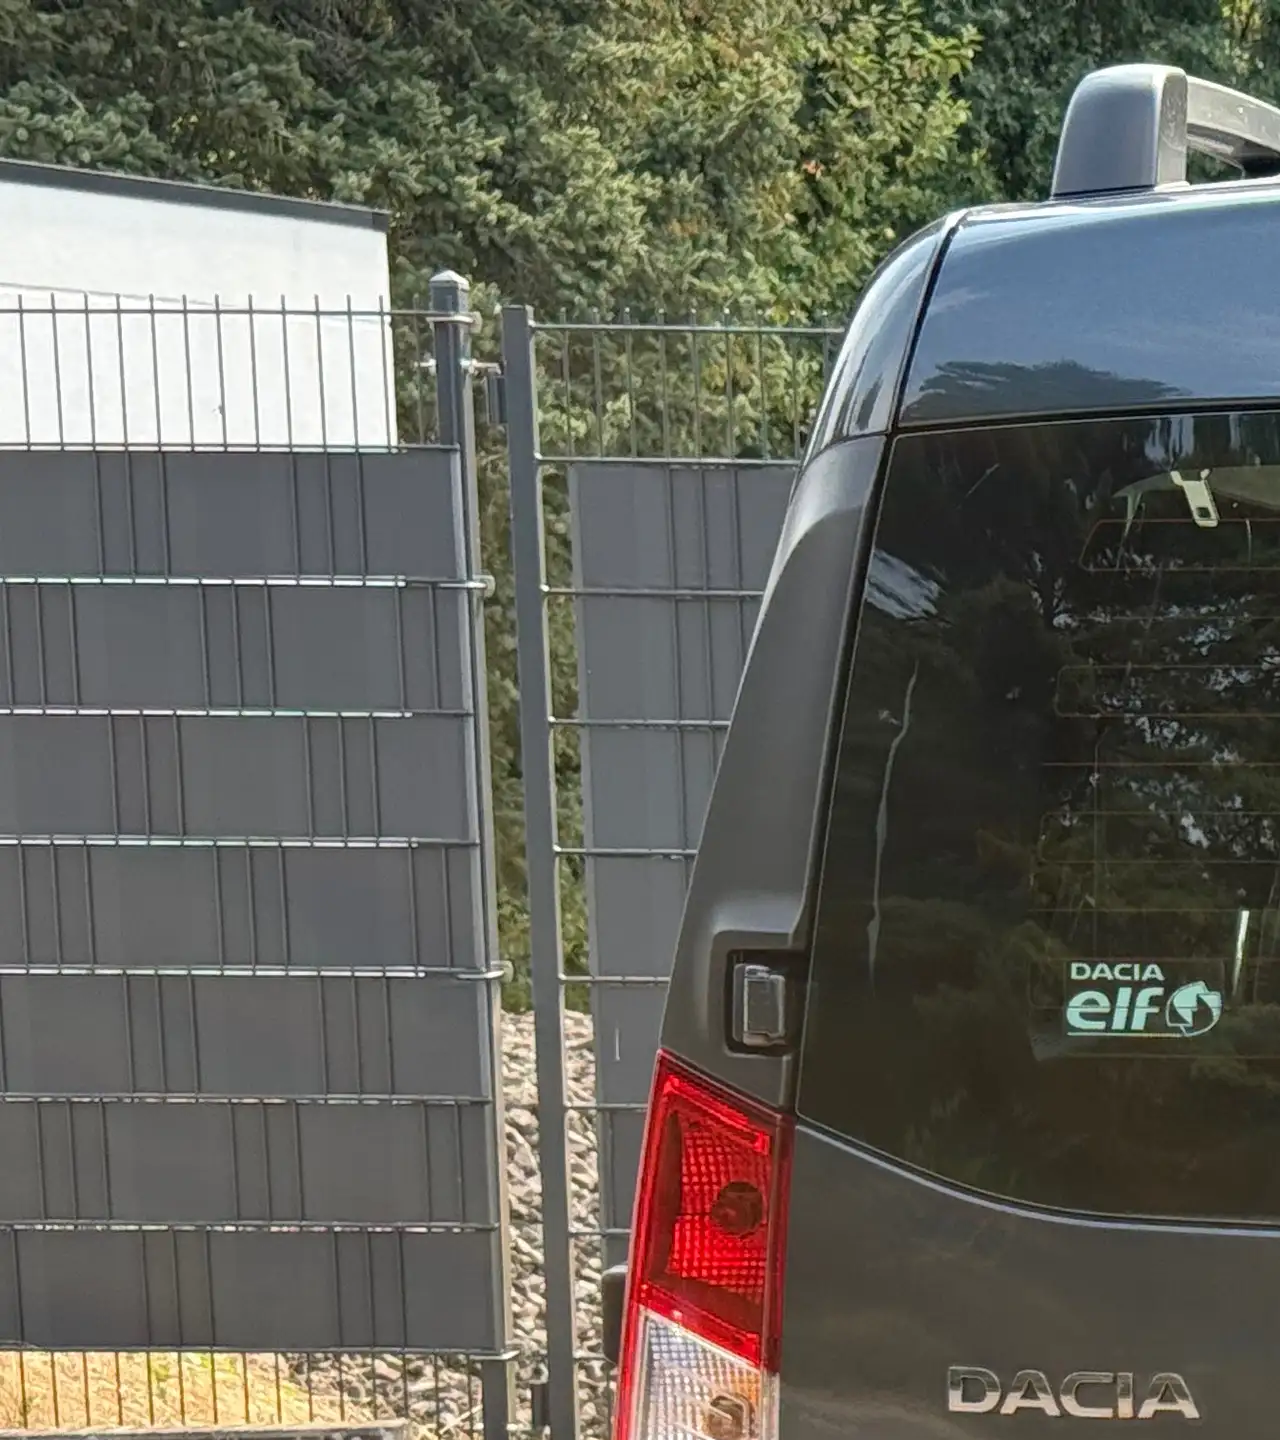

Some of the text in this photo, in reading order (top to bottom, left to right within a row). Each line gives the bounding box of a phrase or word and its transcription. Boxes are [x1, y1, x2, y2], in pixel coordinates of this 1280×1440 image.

[1070, 962, 1165, 981] DACIA
[1066, 986, 1164, 1030] elf
[948, 1366, 1200, 1419] DACIA
